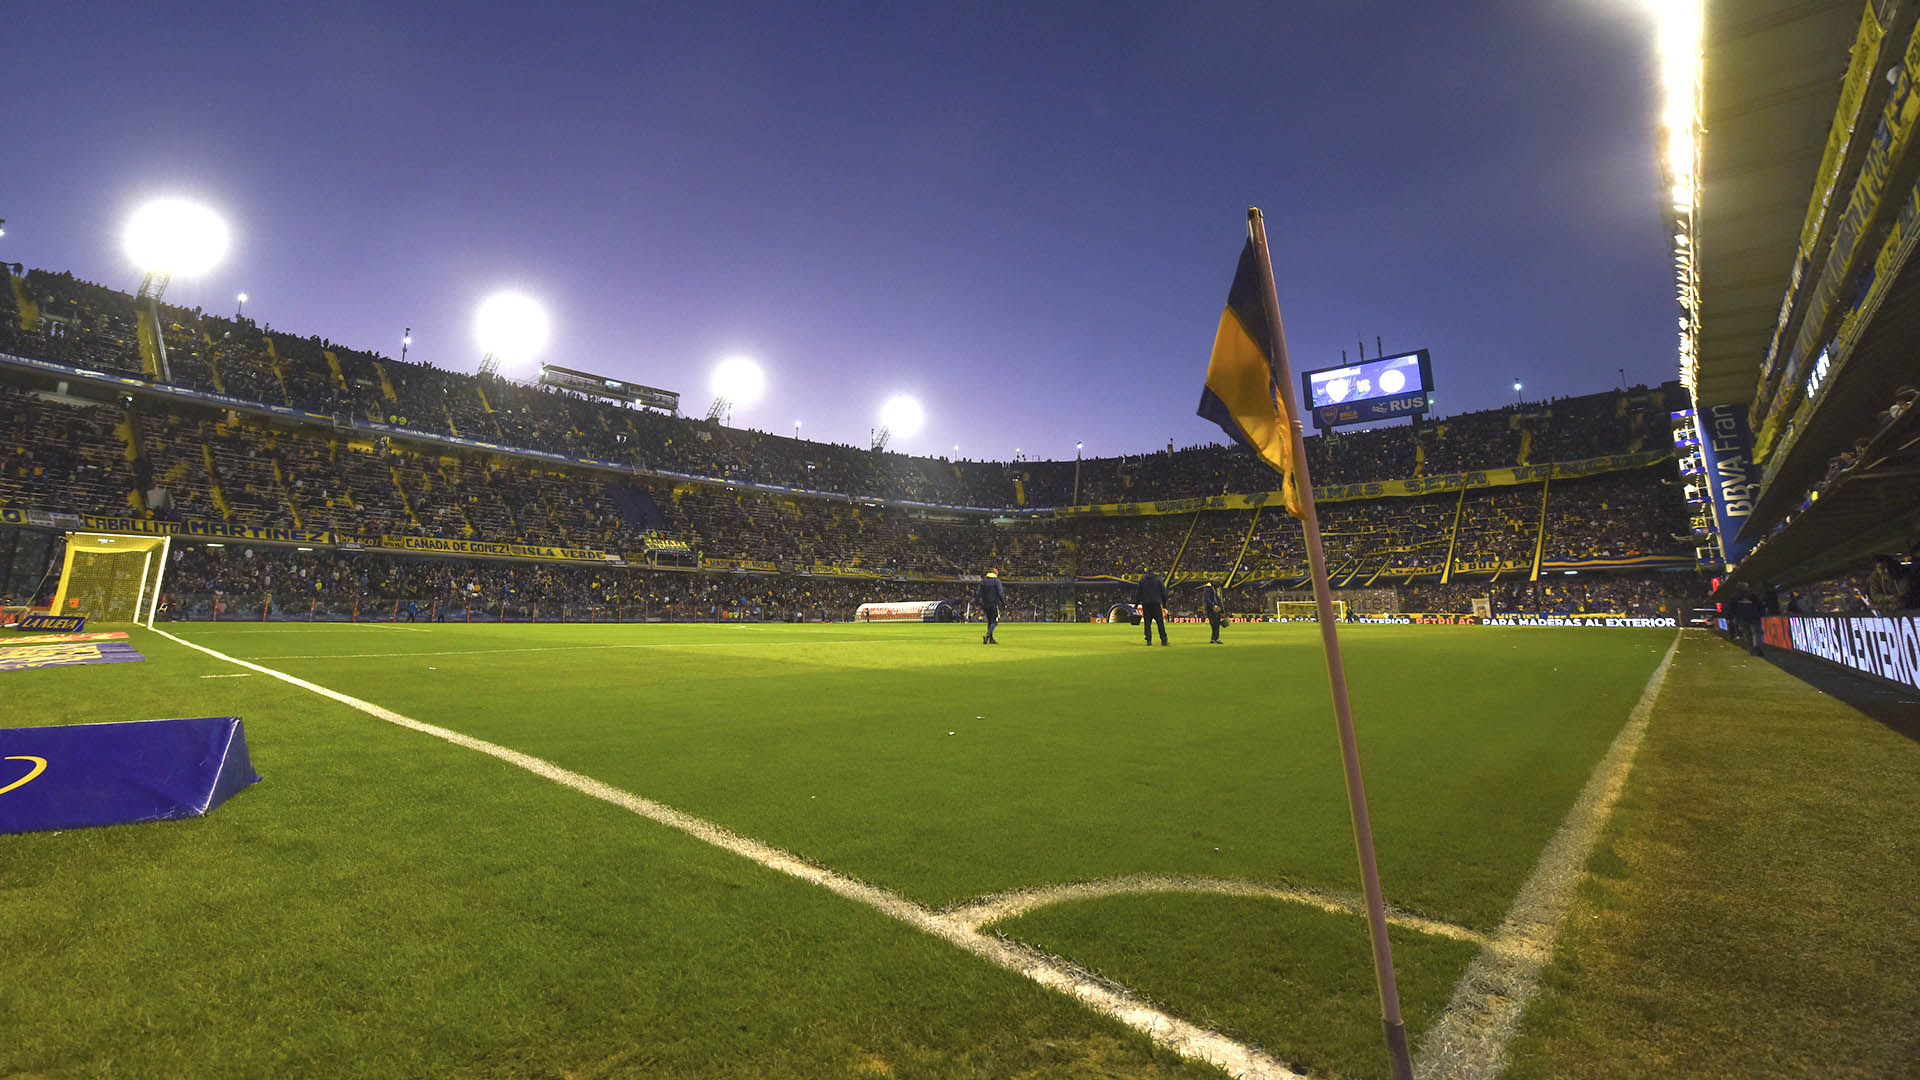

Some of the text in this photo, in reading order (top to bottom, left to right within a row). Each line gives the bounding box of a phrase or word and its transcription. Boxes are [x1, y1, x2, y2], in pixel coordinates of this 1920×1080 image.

[1390, 397, 1424, 412] RUS
[1712, 404, 1753, 517] BBVA Fran
[84, 514, 178, 535] CABALLITO
[190, 521, 325, 543] MARTINEZ
[453, 542, 468, 552] DE
[522, 547, 606, 560] ISLA VERDE
[22, 618, 79, 630] LA NUEVA
[1482, 618, 1517, 626] PARA
[1519, 618, 1581, 627] MADERAS
[1585, 618, 1603, 627] AL
[1605, 617, 1677, 628] EXTERIOR
[1838, 616, 1858, 669] AL
